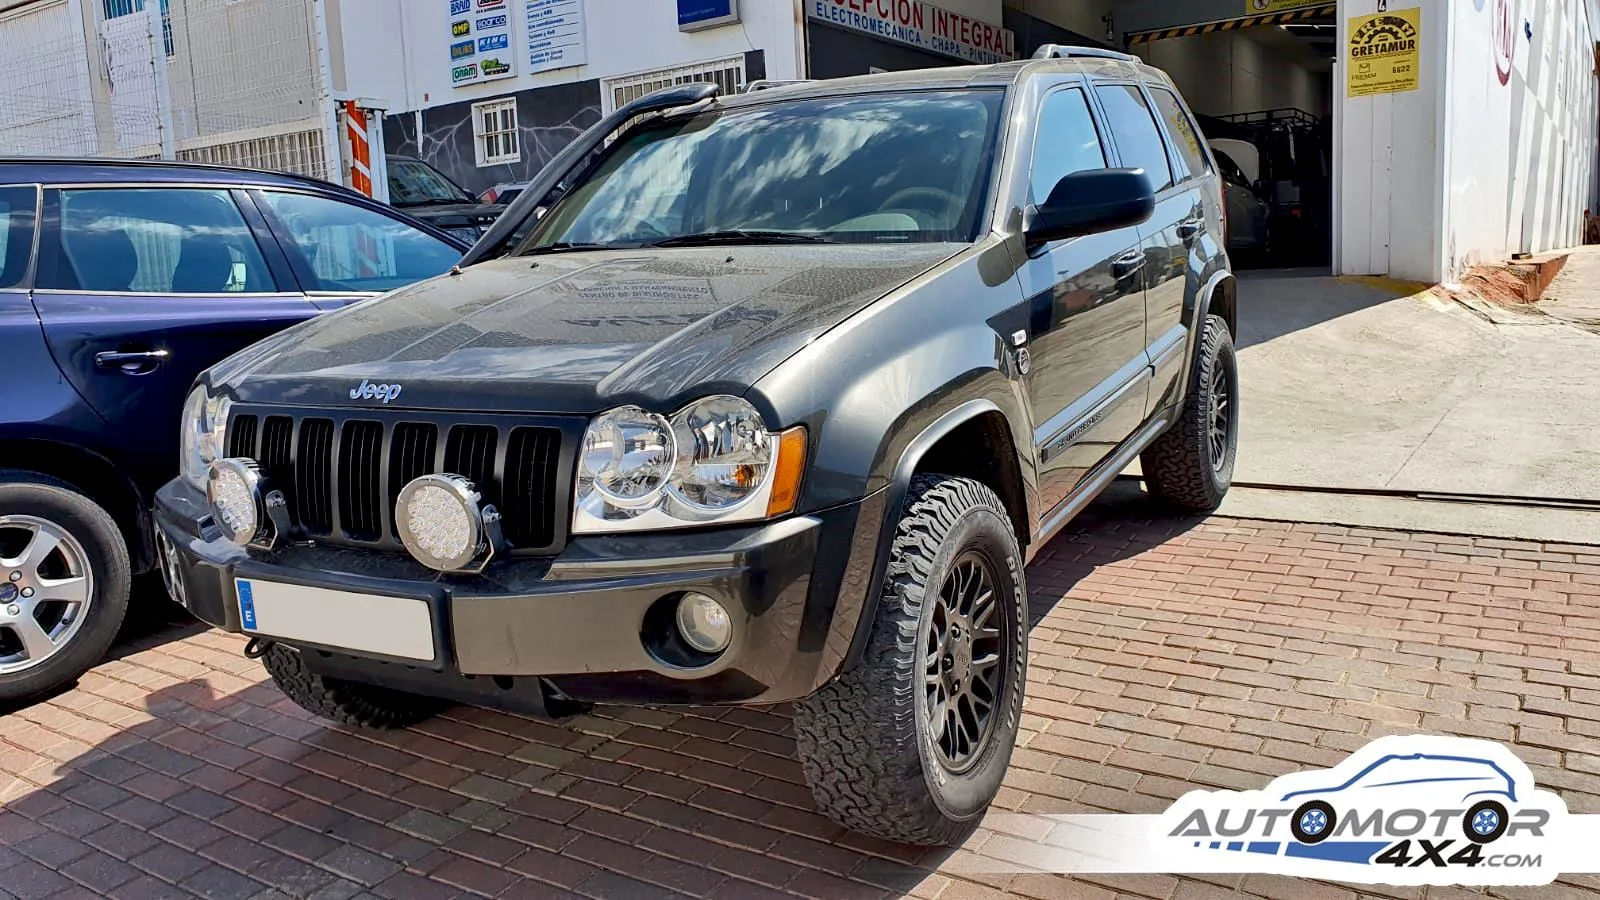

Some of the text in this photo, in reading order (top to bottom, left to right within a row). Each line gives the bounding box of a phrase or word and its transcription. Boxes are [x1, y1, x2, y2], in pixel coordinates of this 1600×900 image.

[453, 22, 469, 35] OMP
[816, 2, 922, 44] ELECTROMECANICA
[931, 36, 961, 56] CHAPA
[932, 8, 1013, 58] INTEGRAL
[480, 35, 506, 47] KING
[1351, 39, 1416, 57] GRETAMUR
[349, 379, 402, 404] Jeep
[244, 610, 253, 622] E
